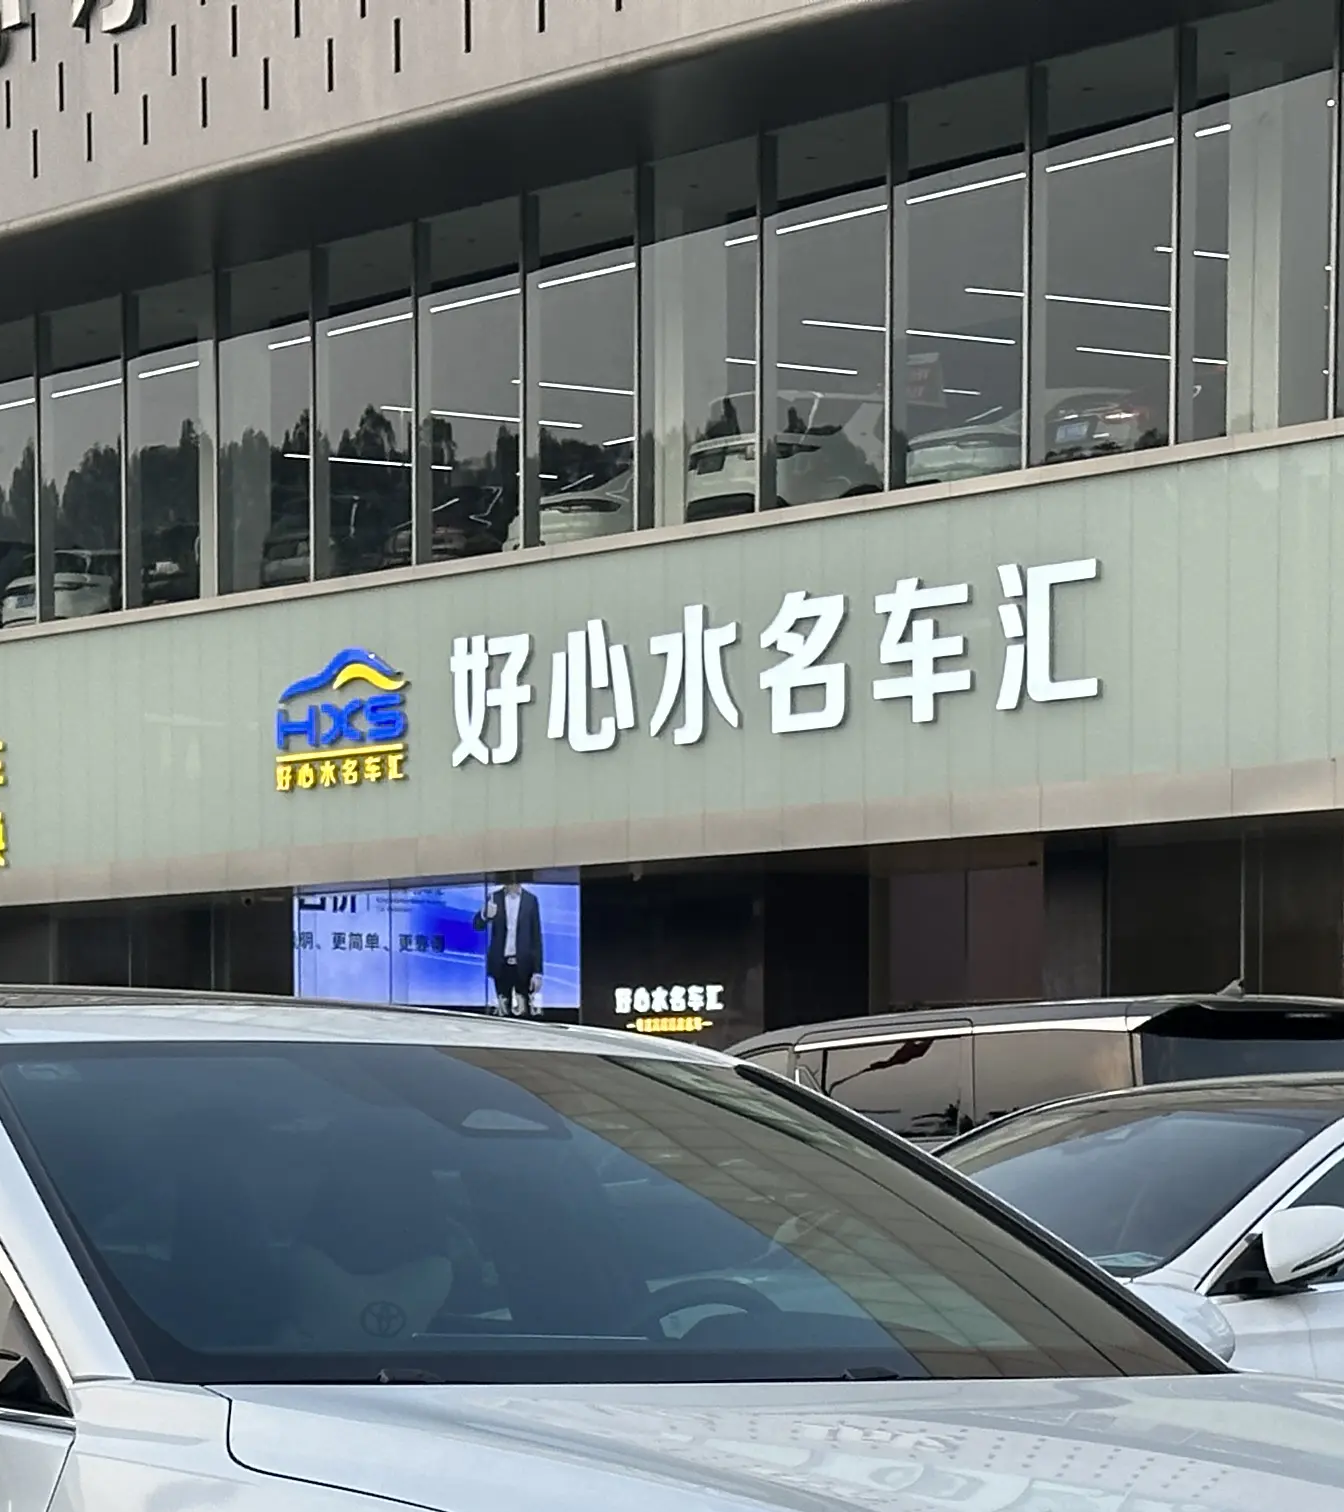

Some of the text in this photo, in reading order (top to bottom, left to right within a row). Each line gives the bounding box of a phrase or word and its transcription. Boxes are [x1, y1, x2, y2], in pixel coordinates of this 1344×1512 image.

[451, 559, 1100, 766] 好心水名车汇
[276, 693, 406, 750] HXS
[276, 753, 404, 791] 好心水名车汇
